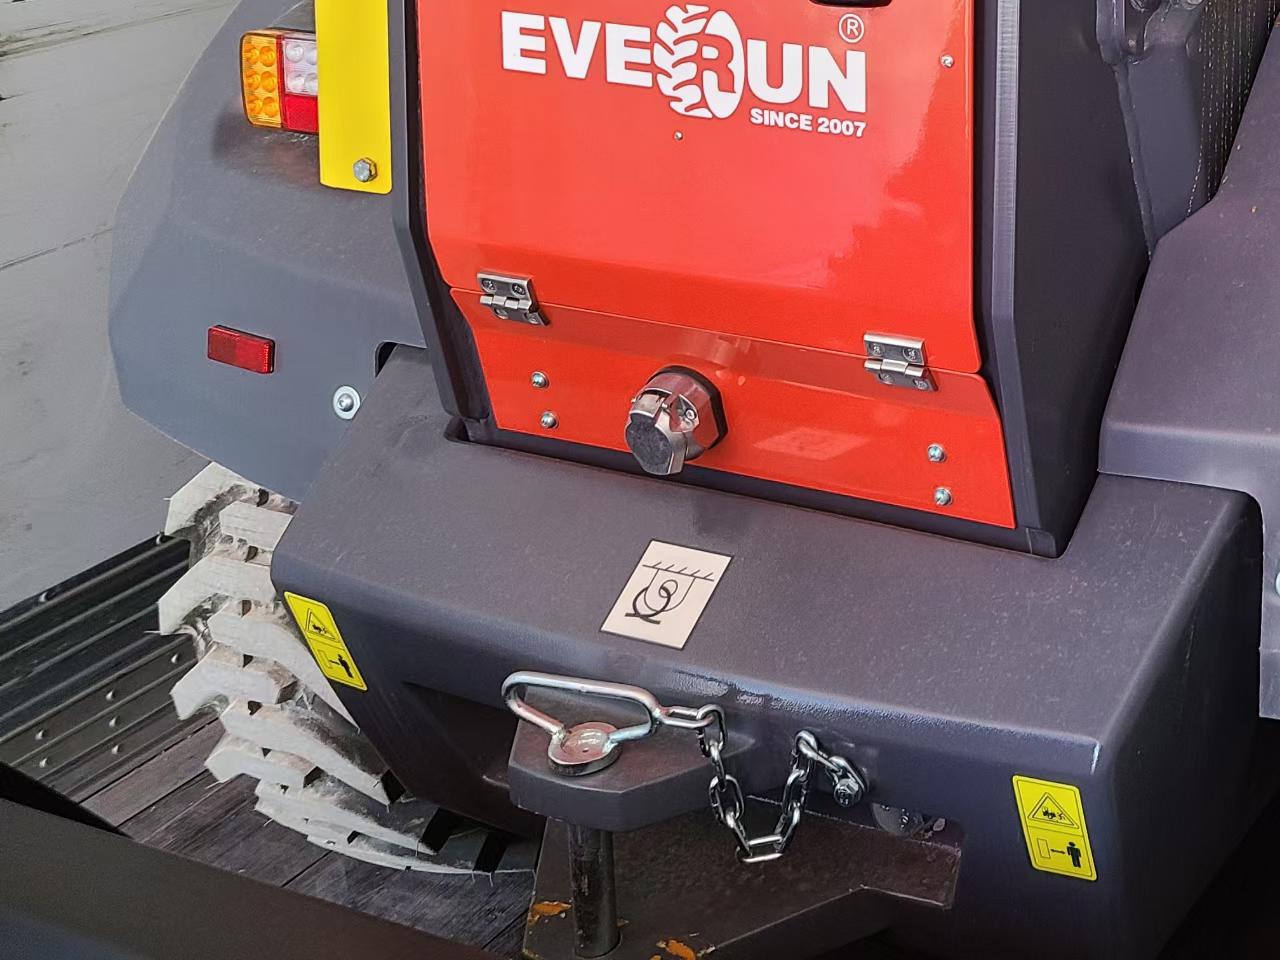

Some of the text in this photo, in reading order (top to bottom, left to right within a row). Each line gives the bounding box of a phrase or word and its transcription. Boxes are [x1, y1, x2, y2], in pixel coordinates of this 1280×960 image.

[501, 4, 866, 119] EVERUN
[750, 108, 867, 137] SINCE 2007
